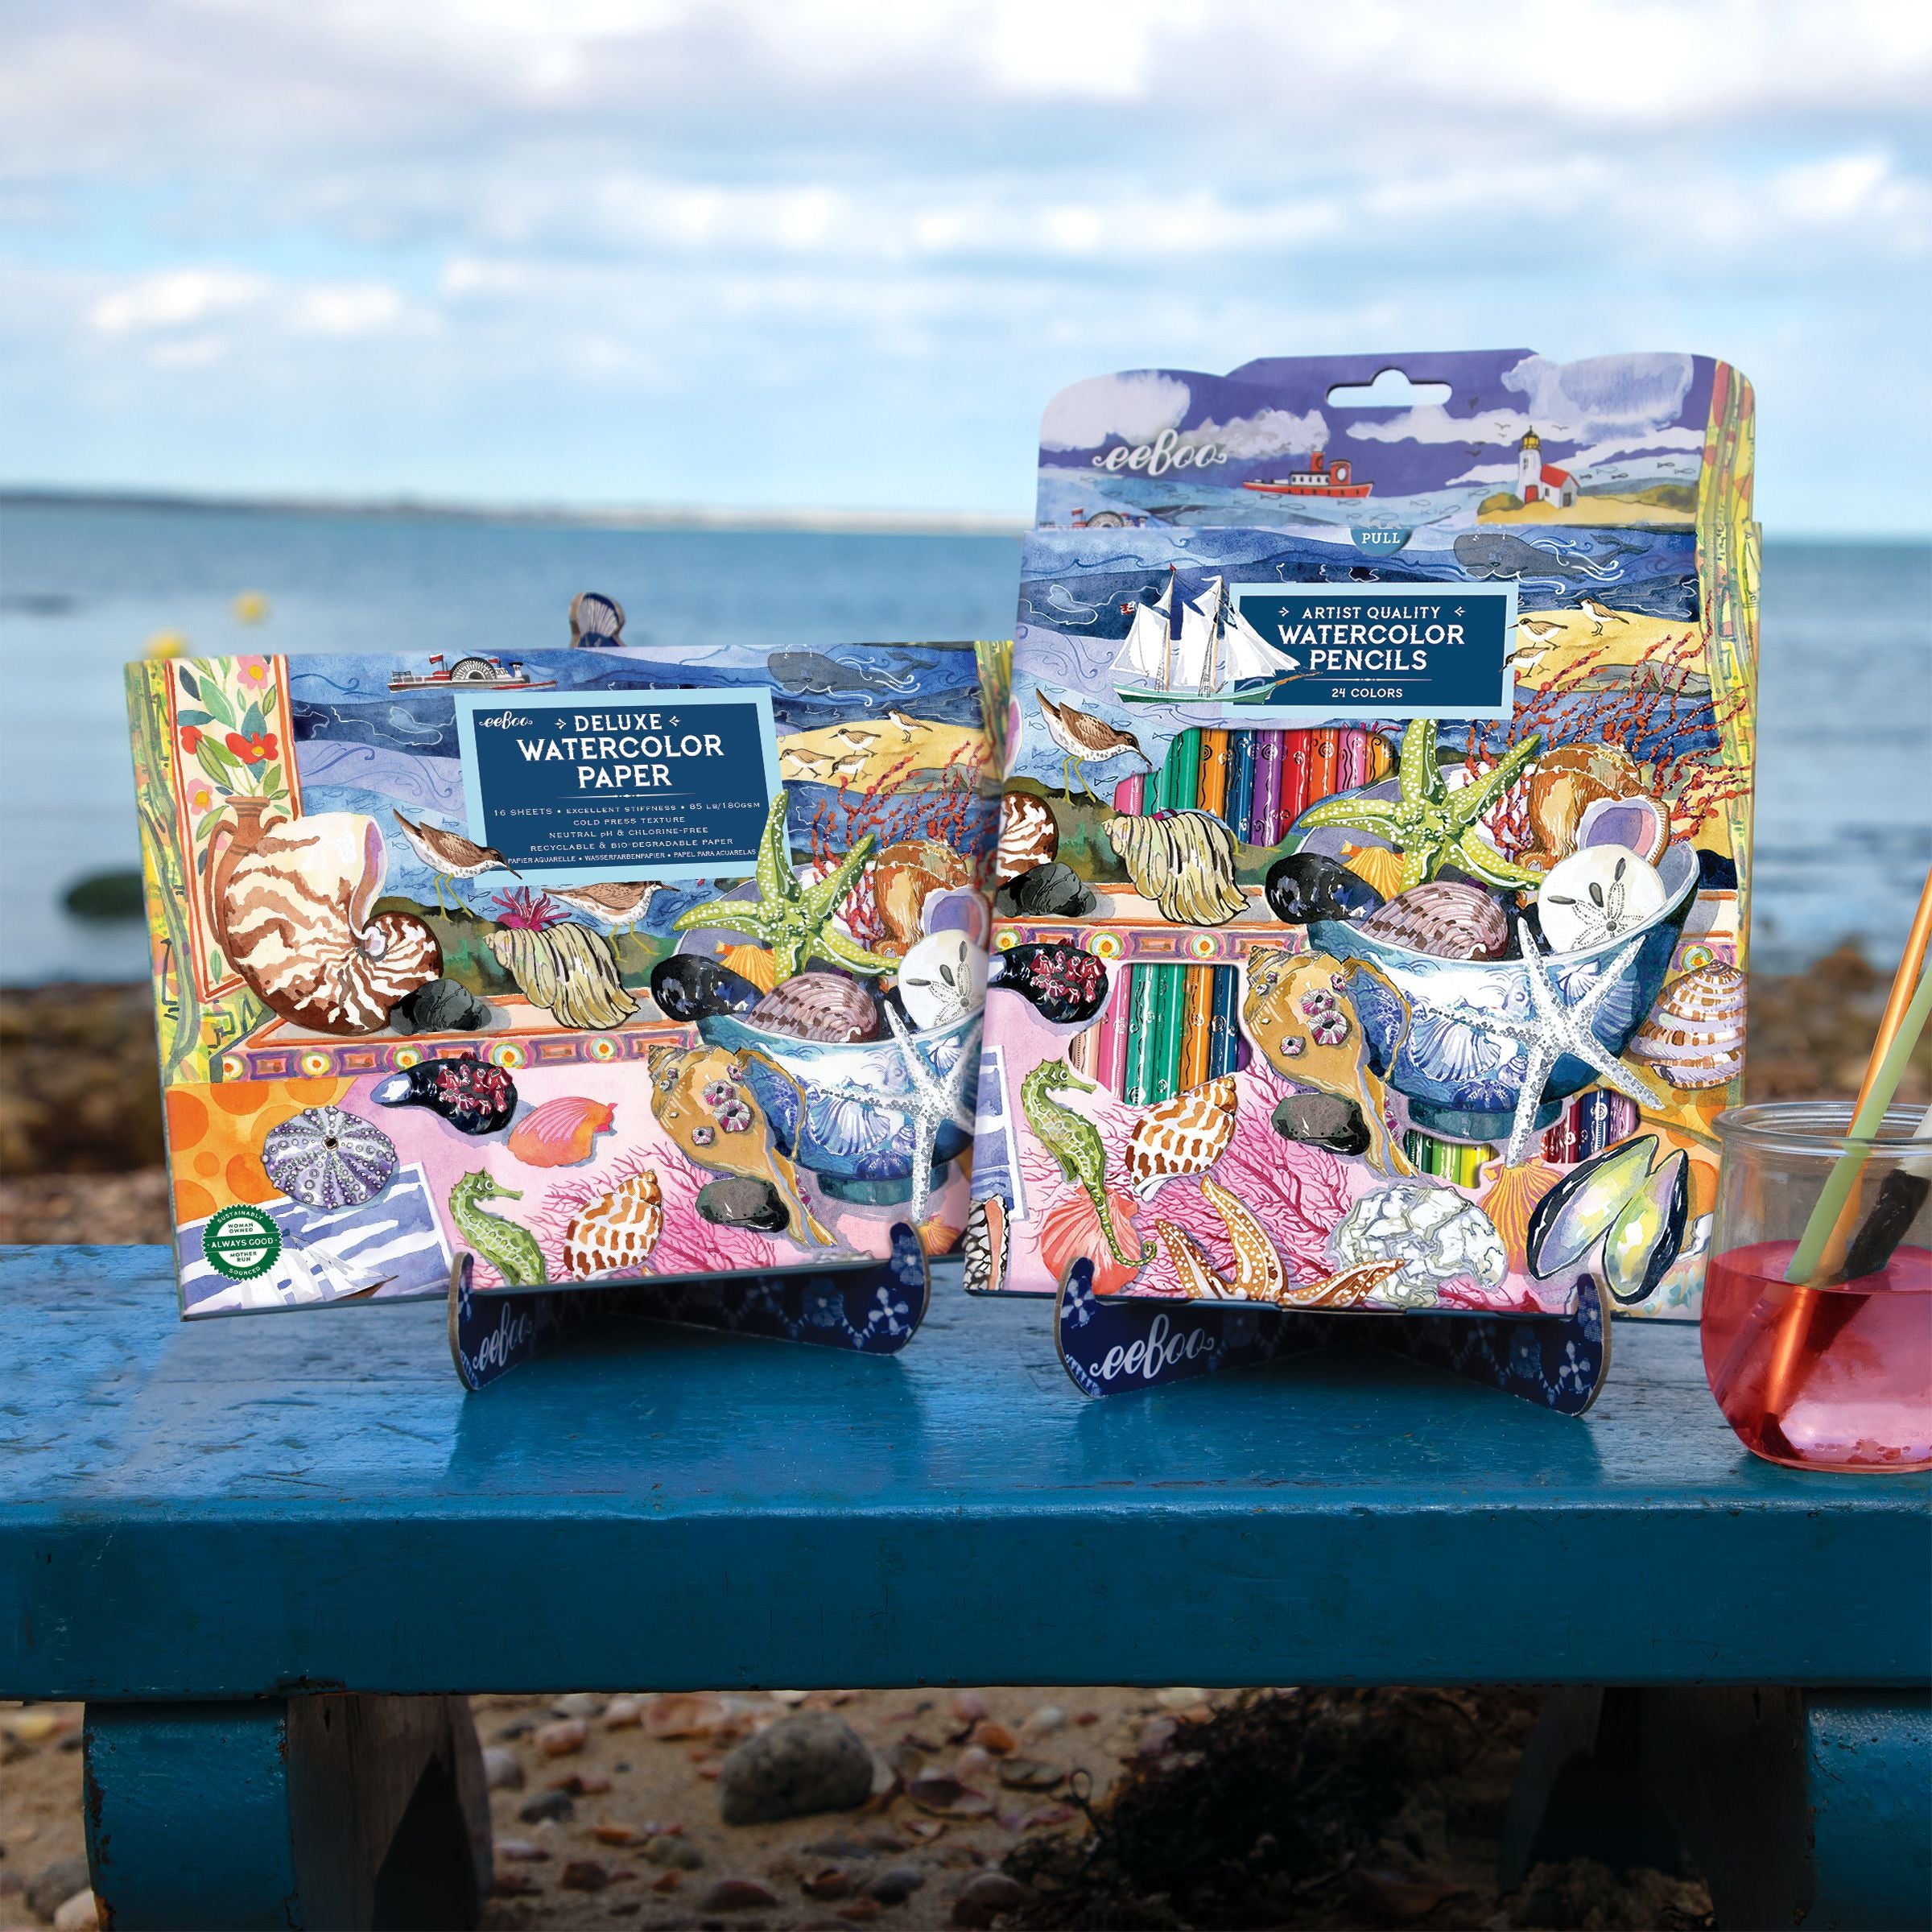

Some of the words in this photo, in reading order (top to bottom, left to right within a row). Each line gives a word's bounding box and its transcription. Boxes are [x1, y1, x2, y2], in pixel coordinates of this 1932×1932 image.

[1092, 427, 1228, 477] eeboo
[1361, 532, 1401, 544] PULL
[1302, 606, 1361, 620] ARTIST
[1367, 605, 1441, 620] QUALITY
[1277, 624, 1465, 645] WATERCOLOR
[1310, 649, 1428, 671] PENCILS
[1331, 687, 1346, 699] 24
[1350, 687, 1403, 699] COLORS
[479, 711, 533, 729] eeboo
[574, 713, 663, 733] DELUXE
[516, 734, 724, 762] WATERCOLOR
[576, 764, 672, 789] PAPER
[510, 807, 553, 816] SHEETS
[601, 830, 613, 838] pH
[628, 827, 708, 836] CHLORINE-FREE
[530, 843, 595, 852] RECYCLABLE
[599, 841, 606, 849] &
[611, 840, 699, 848] BIO-DEGRADABLE
[534, 856, 576, 864] AQUARELLE
[584, 852, 665, 861] WASSERFARBENPAPIER
[716, 848, 757, 857] ACUARELAS
[217, 1210, 263, 1224] SUSTAINABLY
[211, 1239, 247, 1249] ALWAYS
[249, 1237, 274, 1245] GOOD
[229, 1266, 261, 1276] SOURCED
[1089, 1313, 1215, 1380] eeboo
